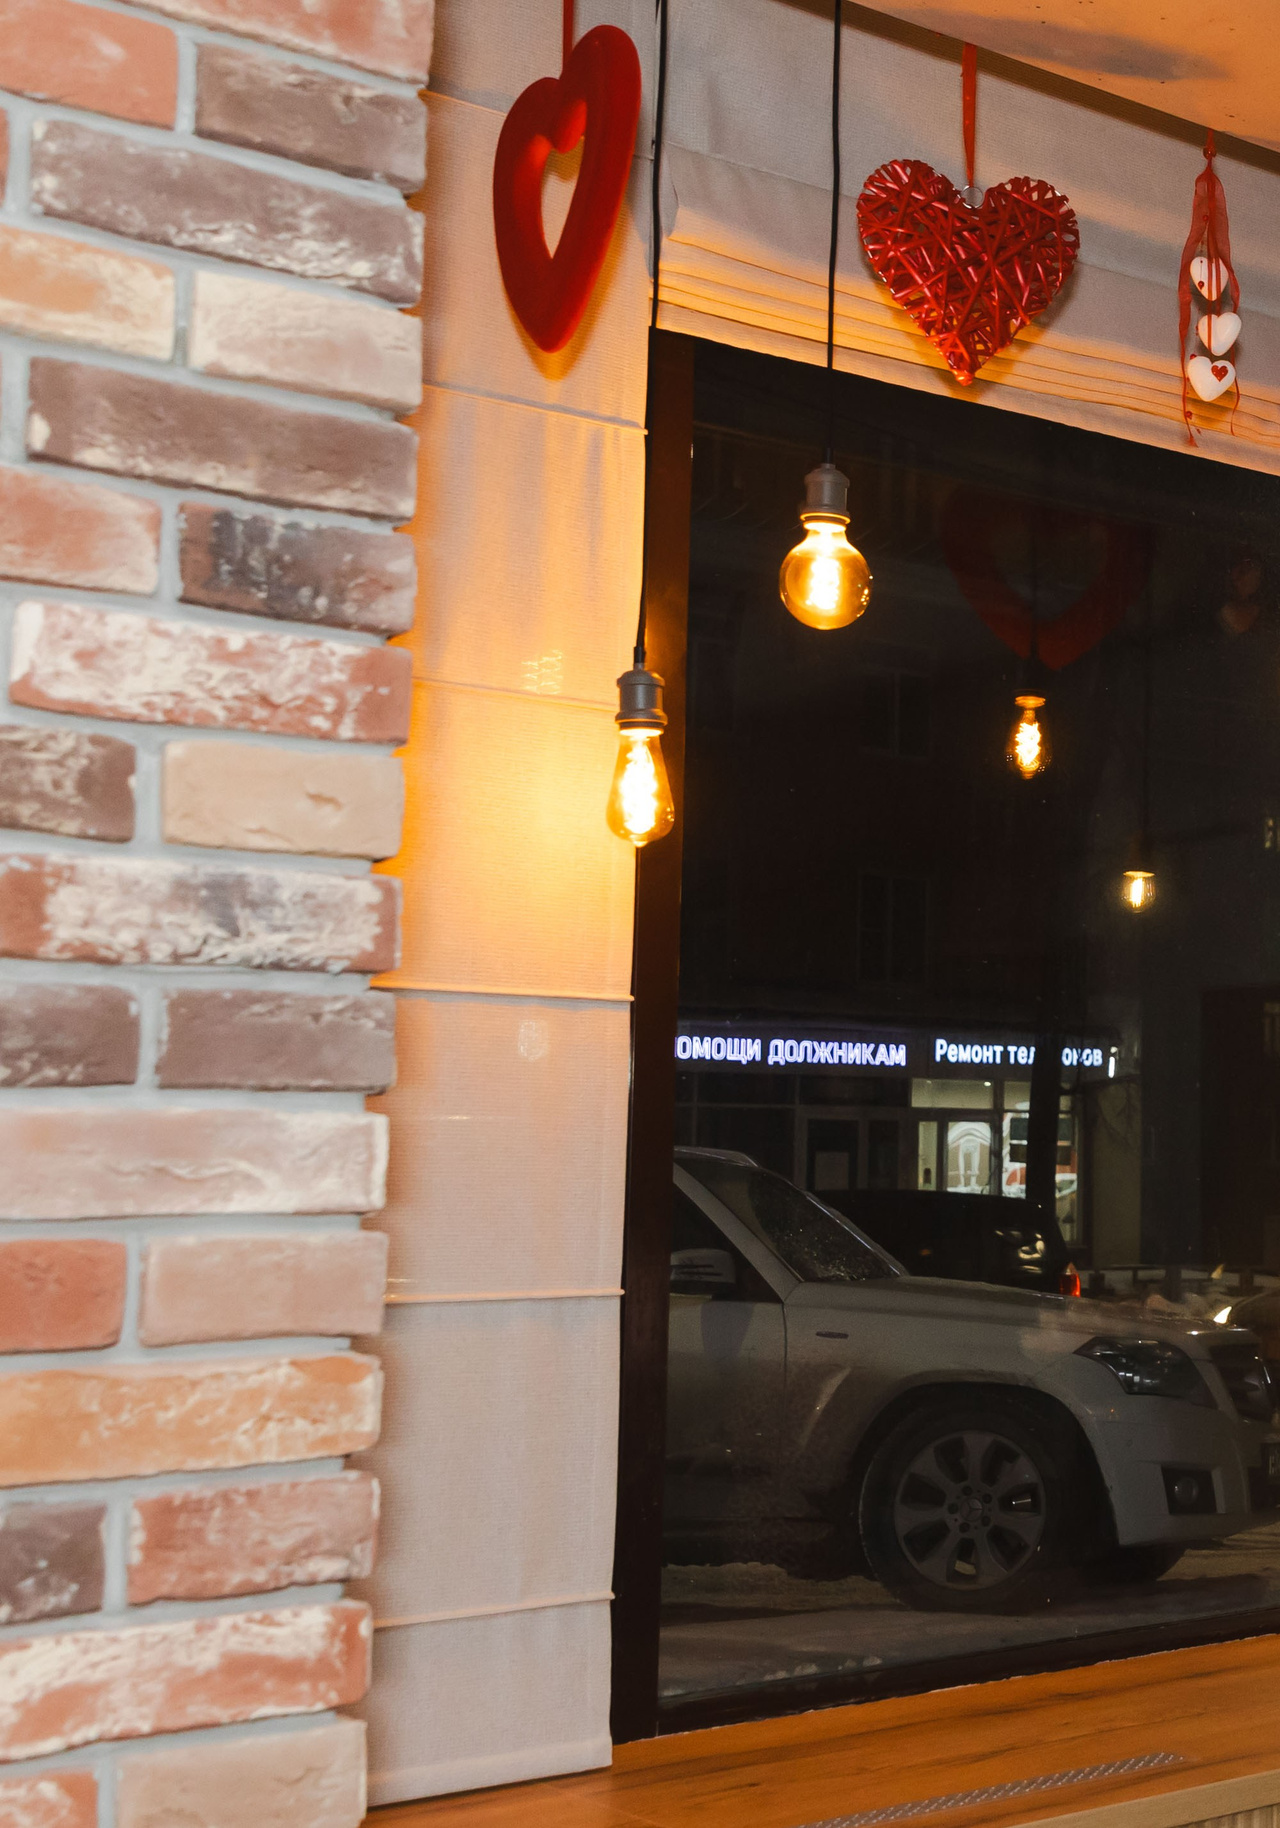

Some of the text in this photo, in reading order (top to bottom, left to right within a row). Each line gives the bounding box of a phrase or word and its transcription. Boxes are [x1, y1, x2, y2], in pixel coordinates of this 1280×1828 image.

[675, 1035, 907, 1066] ОМОЩИ ДОЛЖНИКАМ
[935, 1038, 1103, 1067] Ремонт телонов
